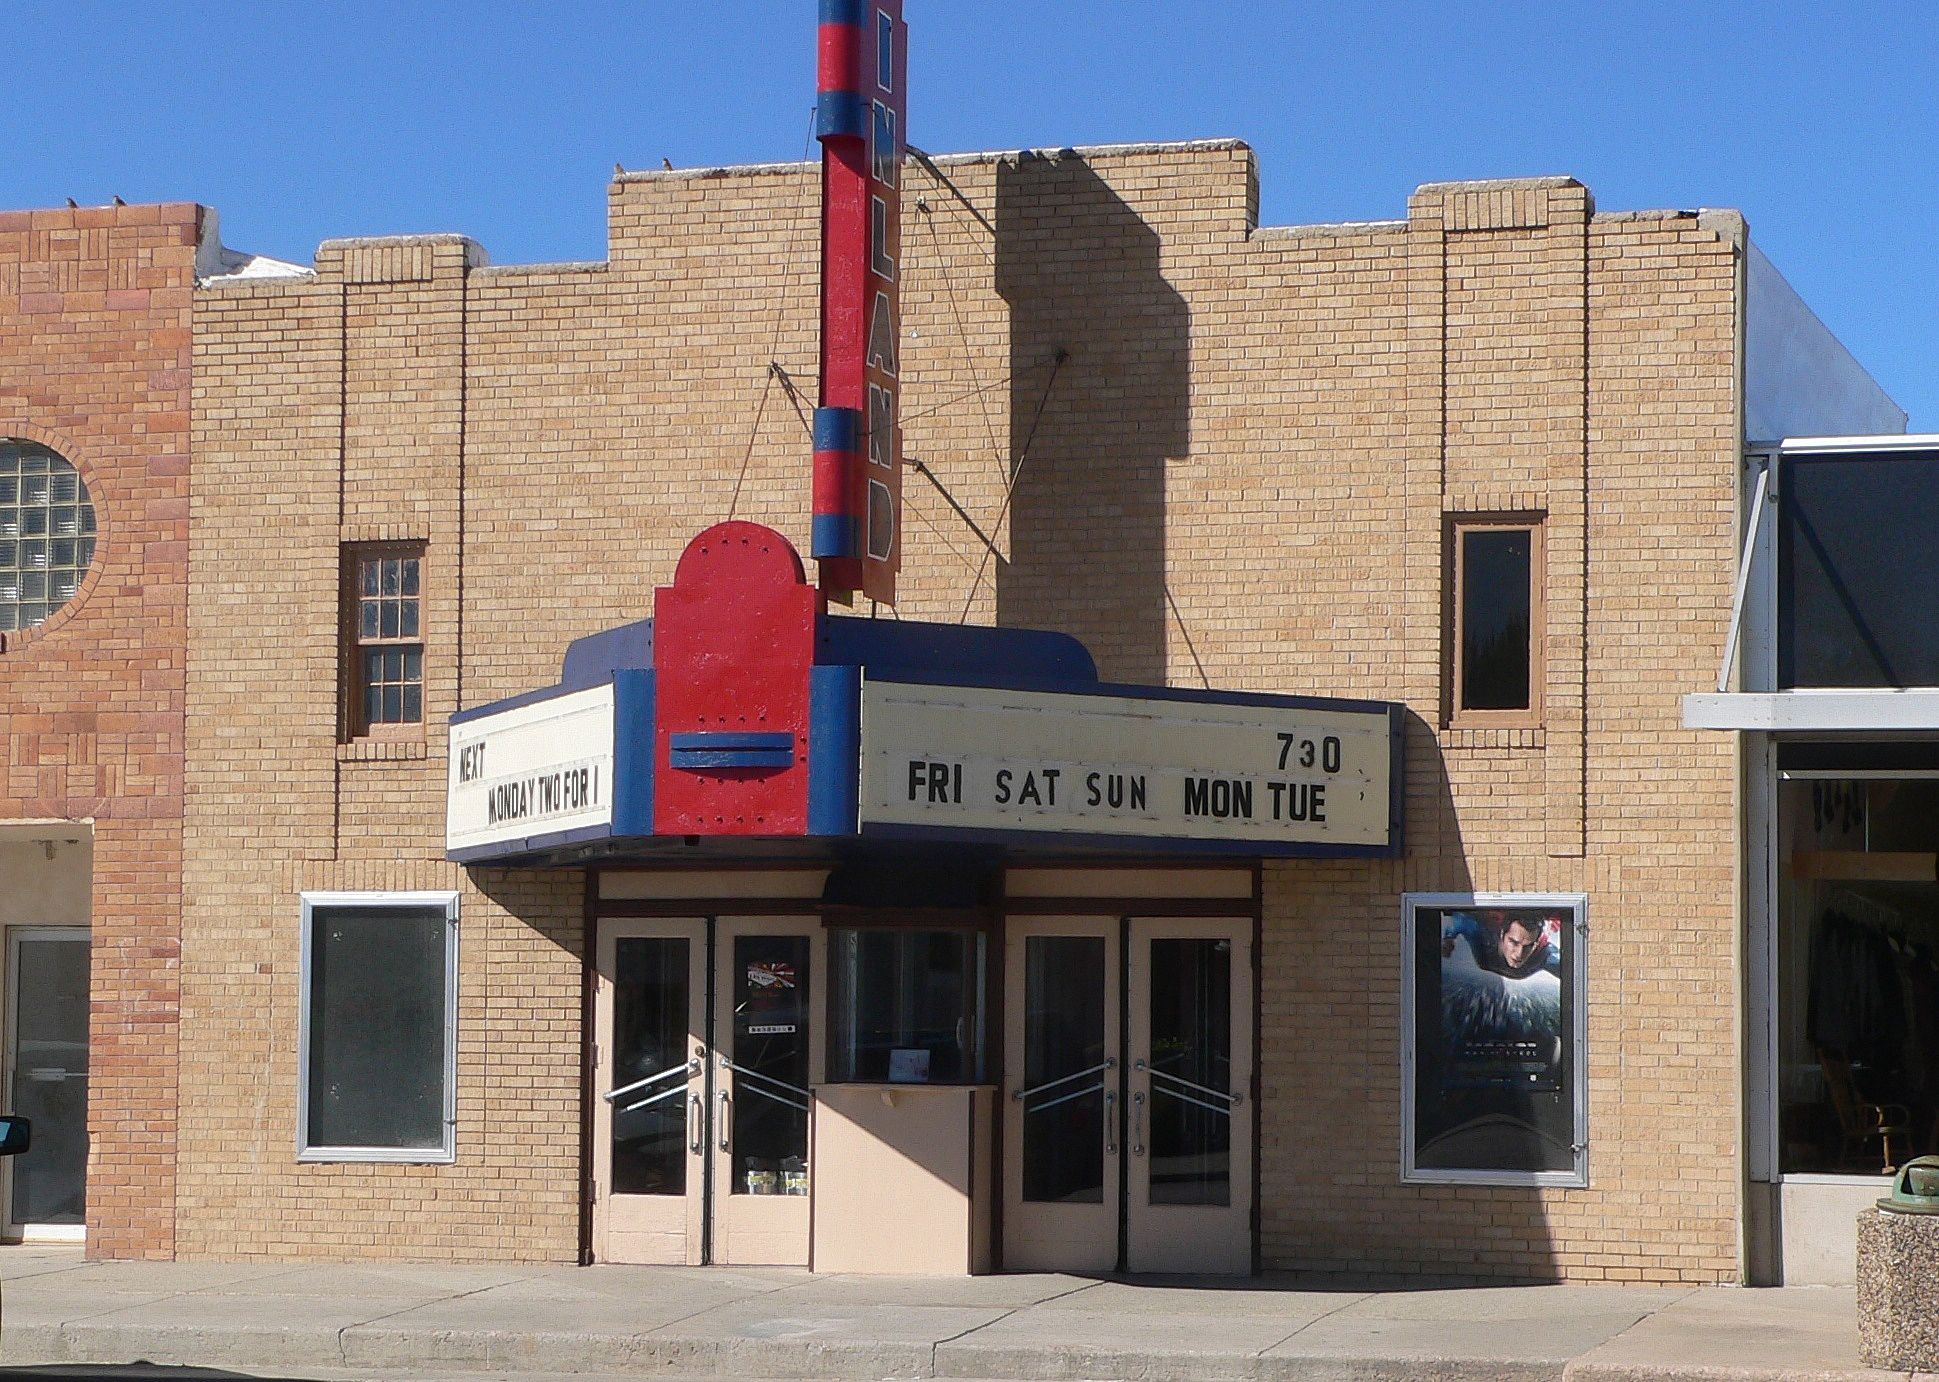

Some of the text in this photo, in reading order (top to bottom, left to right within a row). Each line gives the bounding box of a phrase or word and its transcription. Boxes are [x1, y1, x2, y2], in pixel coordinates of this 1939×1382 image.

[866, 7, 896, 562] INLAND
[460, 741, 486, 784] NEXT
[1277, 732, 1341, 773] 730
[488, 778, 535, 826] MONDAY
[538, 772, 561, 815] TWO
[563, 767, 588, 811] FOR
[908, 761, 1326, 822] FRI SAT SUN MON TUE
